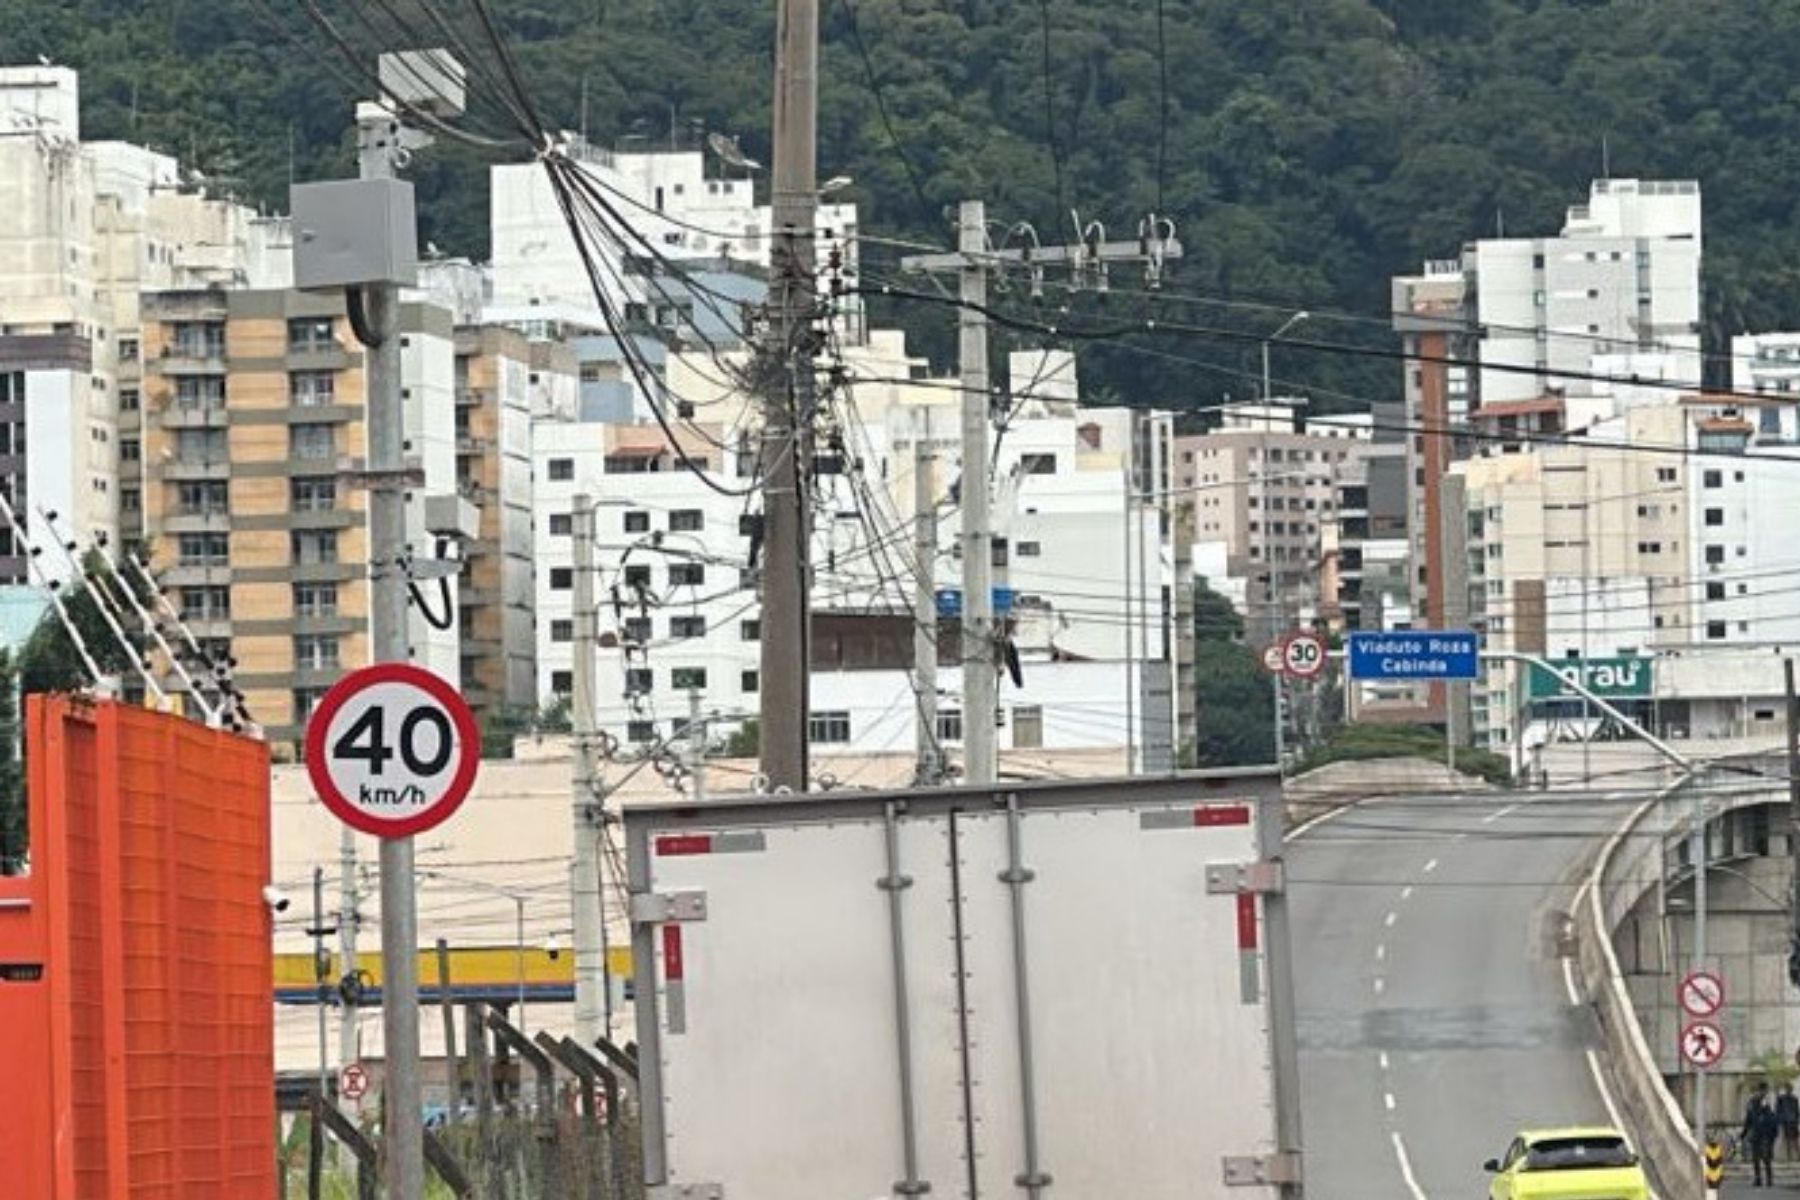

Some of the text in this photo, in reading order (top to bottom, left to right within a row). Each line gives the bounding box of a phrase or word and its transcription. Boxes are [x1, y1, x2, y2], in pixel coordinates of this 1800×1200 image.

[1291, 644, 1317, 661] 30
[1358, 639, 1421, 654] Viaduto
[1381, 657, 1447, 672] Cabinda
[333, 705, 453, 777] 40
[359, 784, 426, 804] km/h
